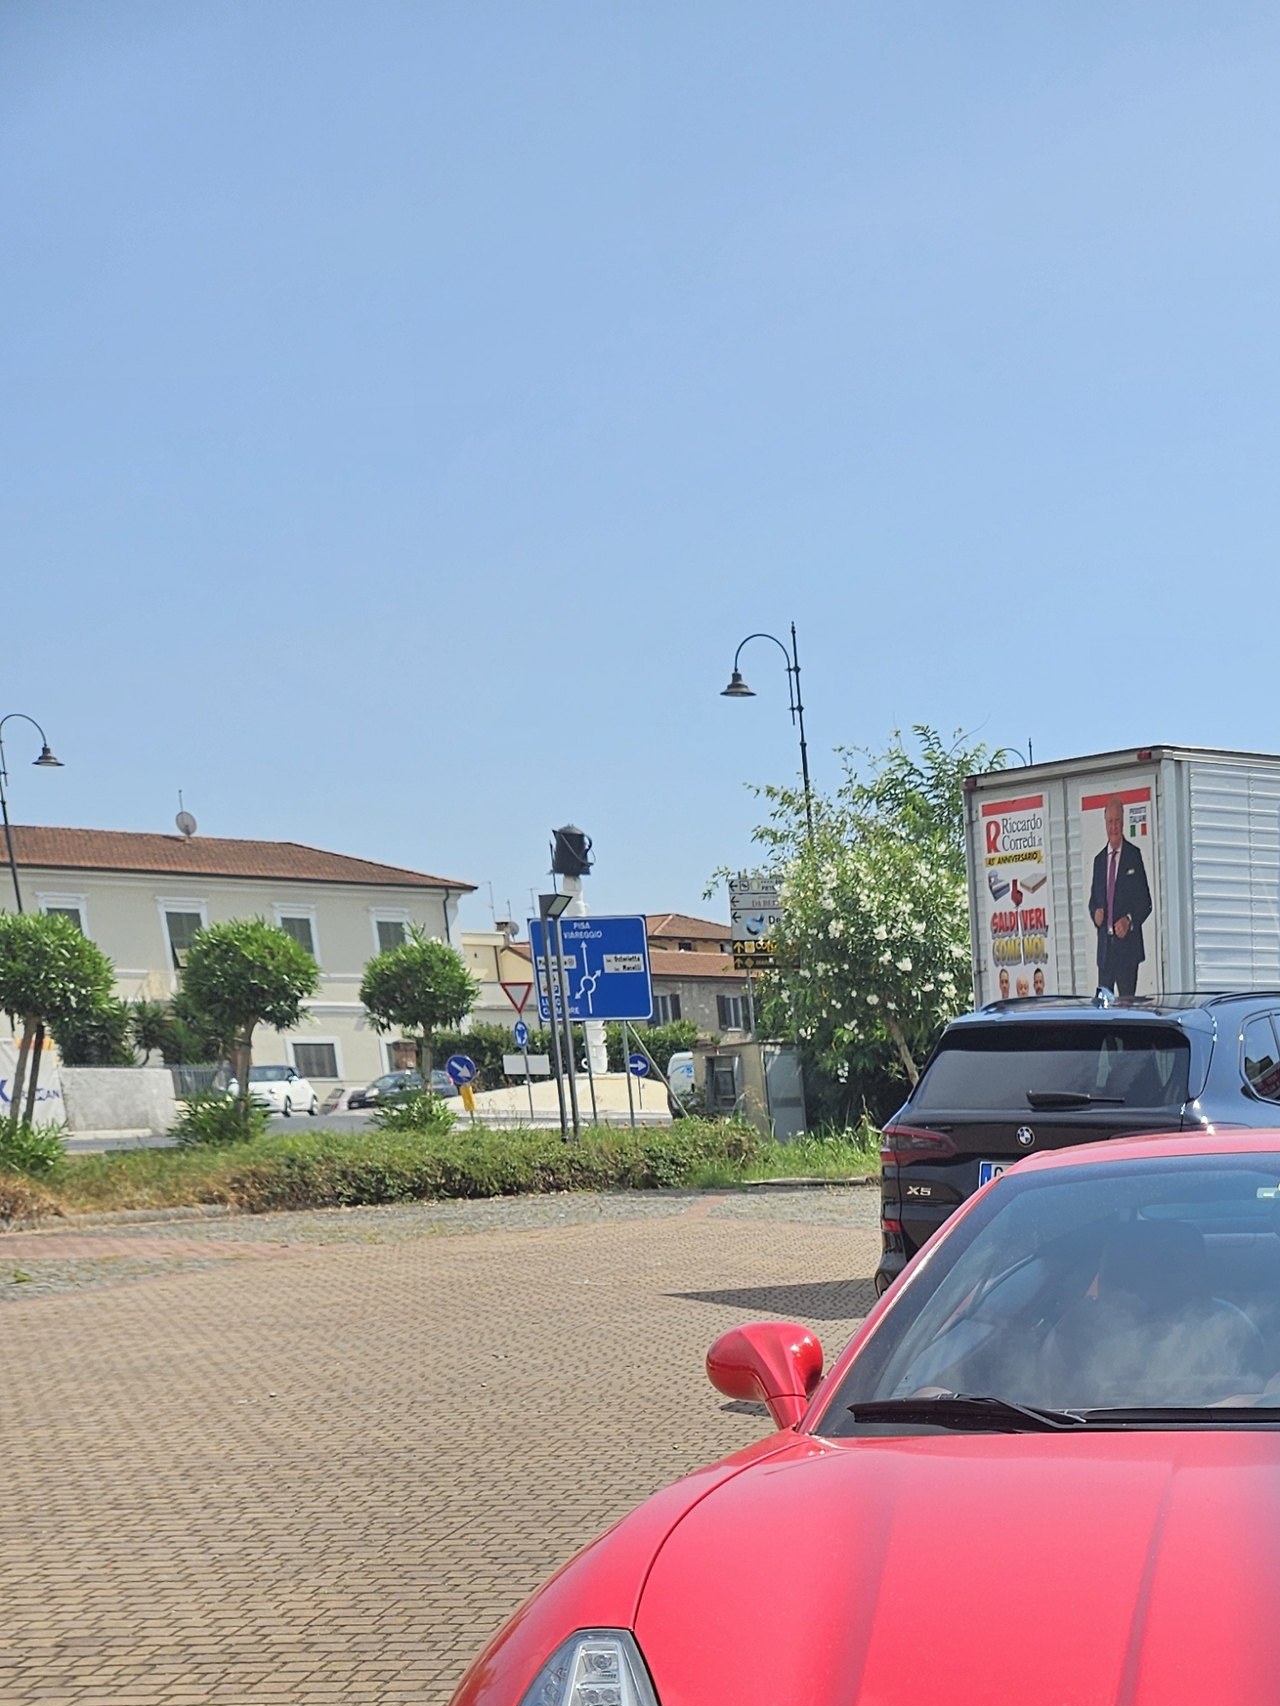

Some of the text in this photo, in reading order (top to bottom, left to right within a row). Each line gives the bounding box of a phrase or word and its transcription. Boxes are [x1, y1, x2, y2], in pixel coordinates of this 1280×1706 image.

[1001, 813, 1042, 835] Riccardo
[573, 922, 591, 930] PISA
[992, 910, 1020, 932] SALDI
[563, 930, 602, 939] VIAREGGIO
[994, 937, 1021, 963] COME
[907, 1185, 932, 1197] X5
